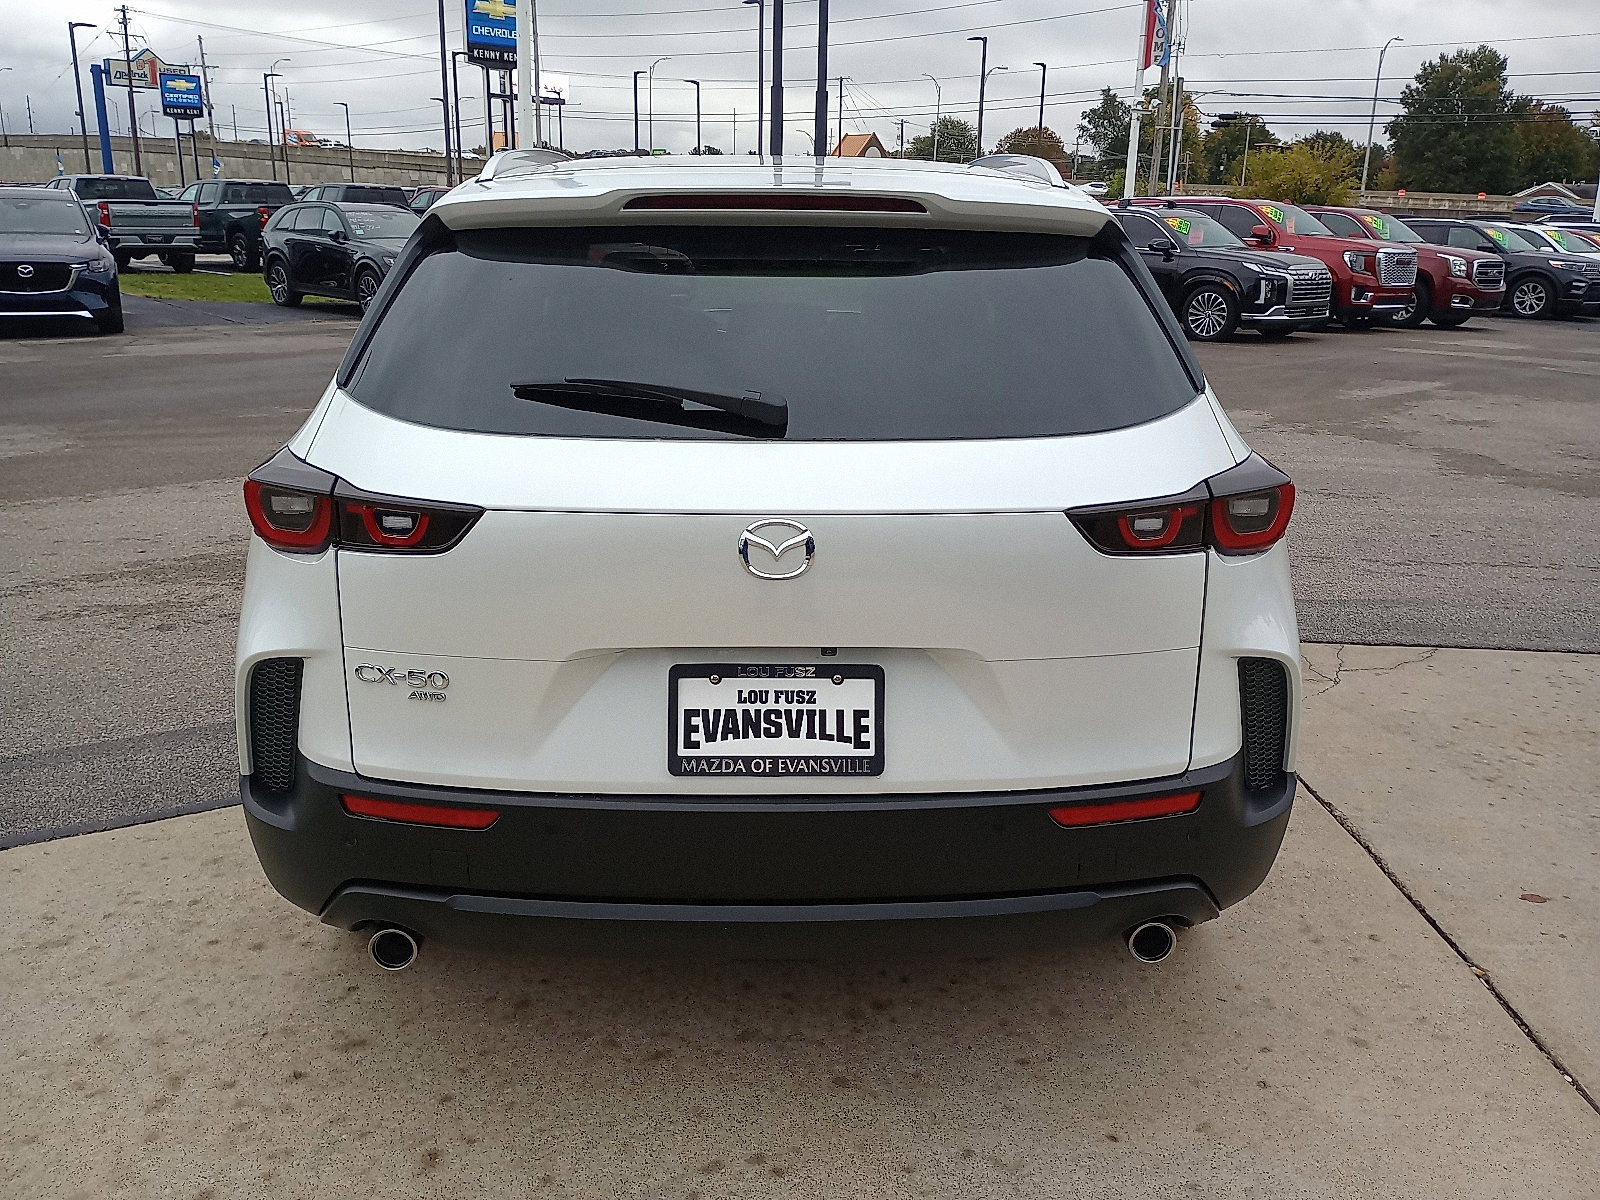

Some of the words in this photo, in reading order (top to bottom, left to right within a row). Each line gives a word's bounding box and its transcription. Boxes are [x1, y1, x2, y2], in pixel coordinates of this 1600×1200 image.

[472, 25, 517, 39] CHEVROLE
[473, 48, 500, 60] KENNY
[503, 52, 518, 62] KEN
[354, 662, 450, 690] CX-50
[737, 666, 769, 678] LOU
[774, 666, 816, 678] FUSZ
[407, 690, 447, 703] AWD
[737, 689, 769, 704] LOU
[773, 689, 817, 704] FUSZ
[683, 708, 871, 750] EVANSVILLE
[681, 758, 747, 773] MAZDA
[750, 758, 774, 773] OF
[778, 758, 871, 773] EVANSVILLE
